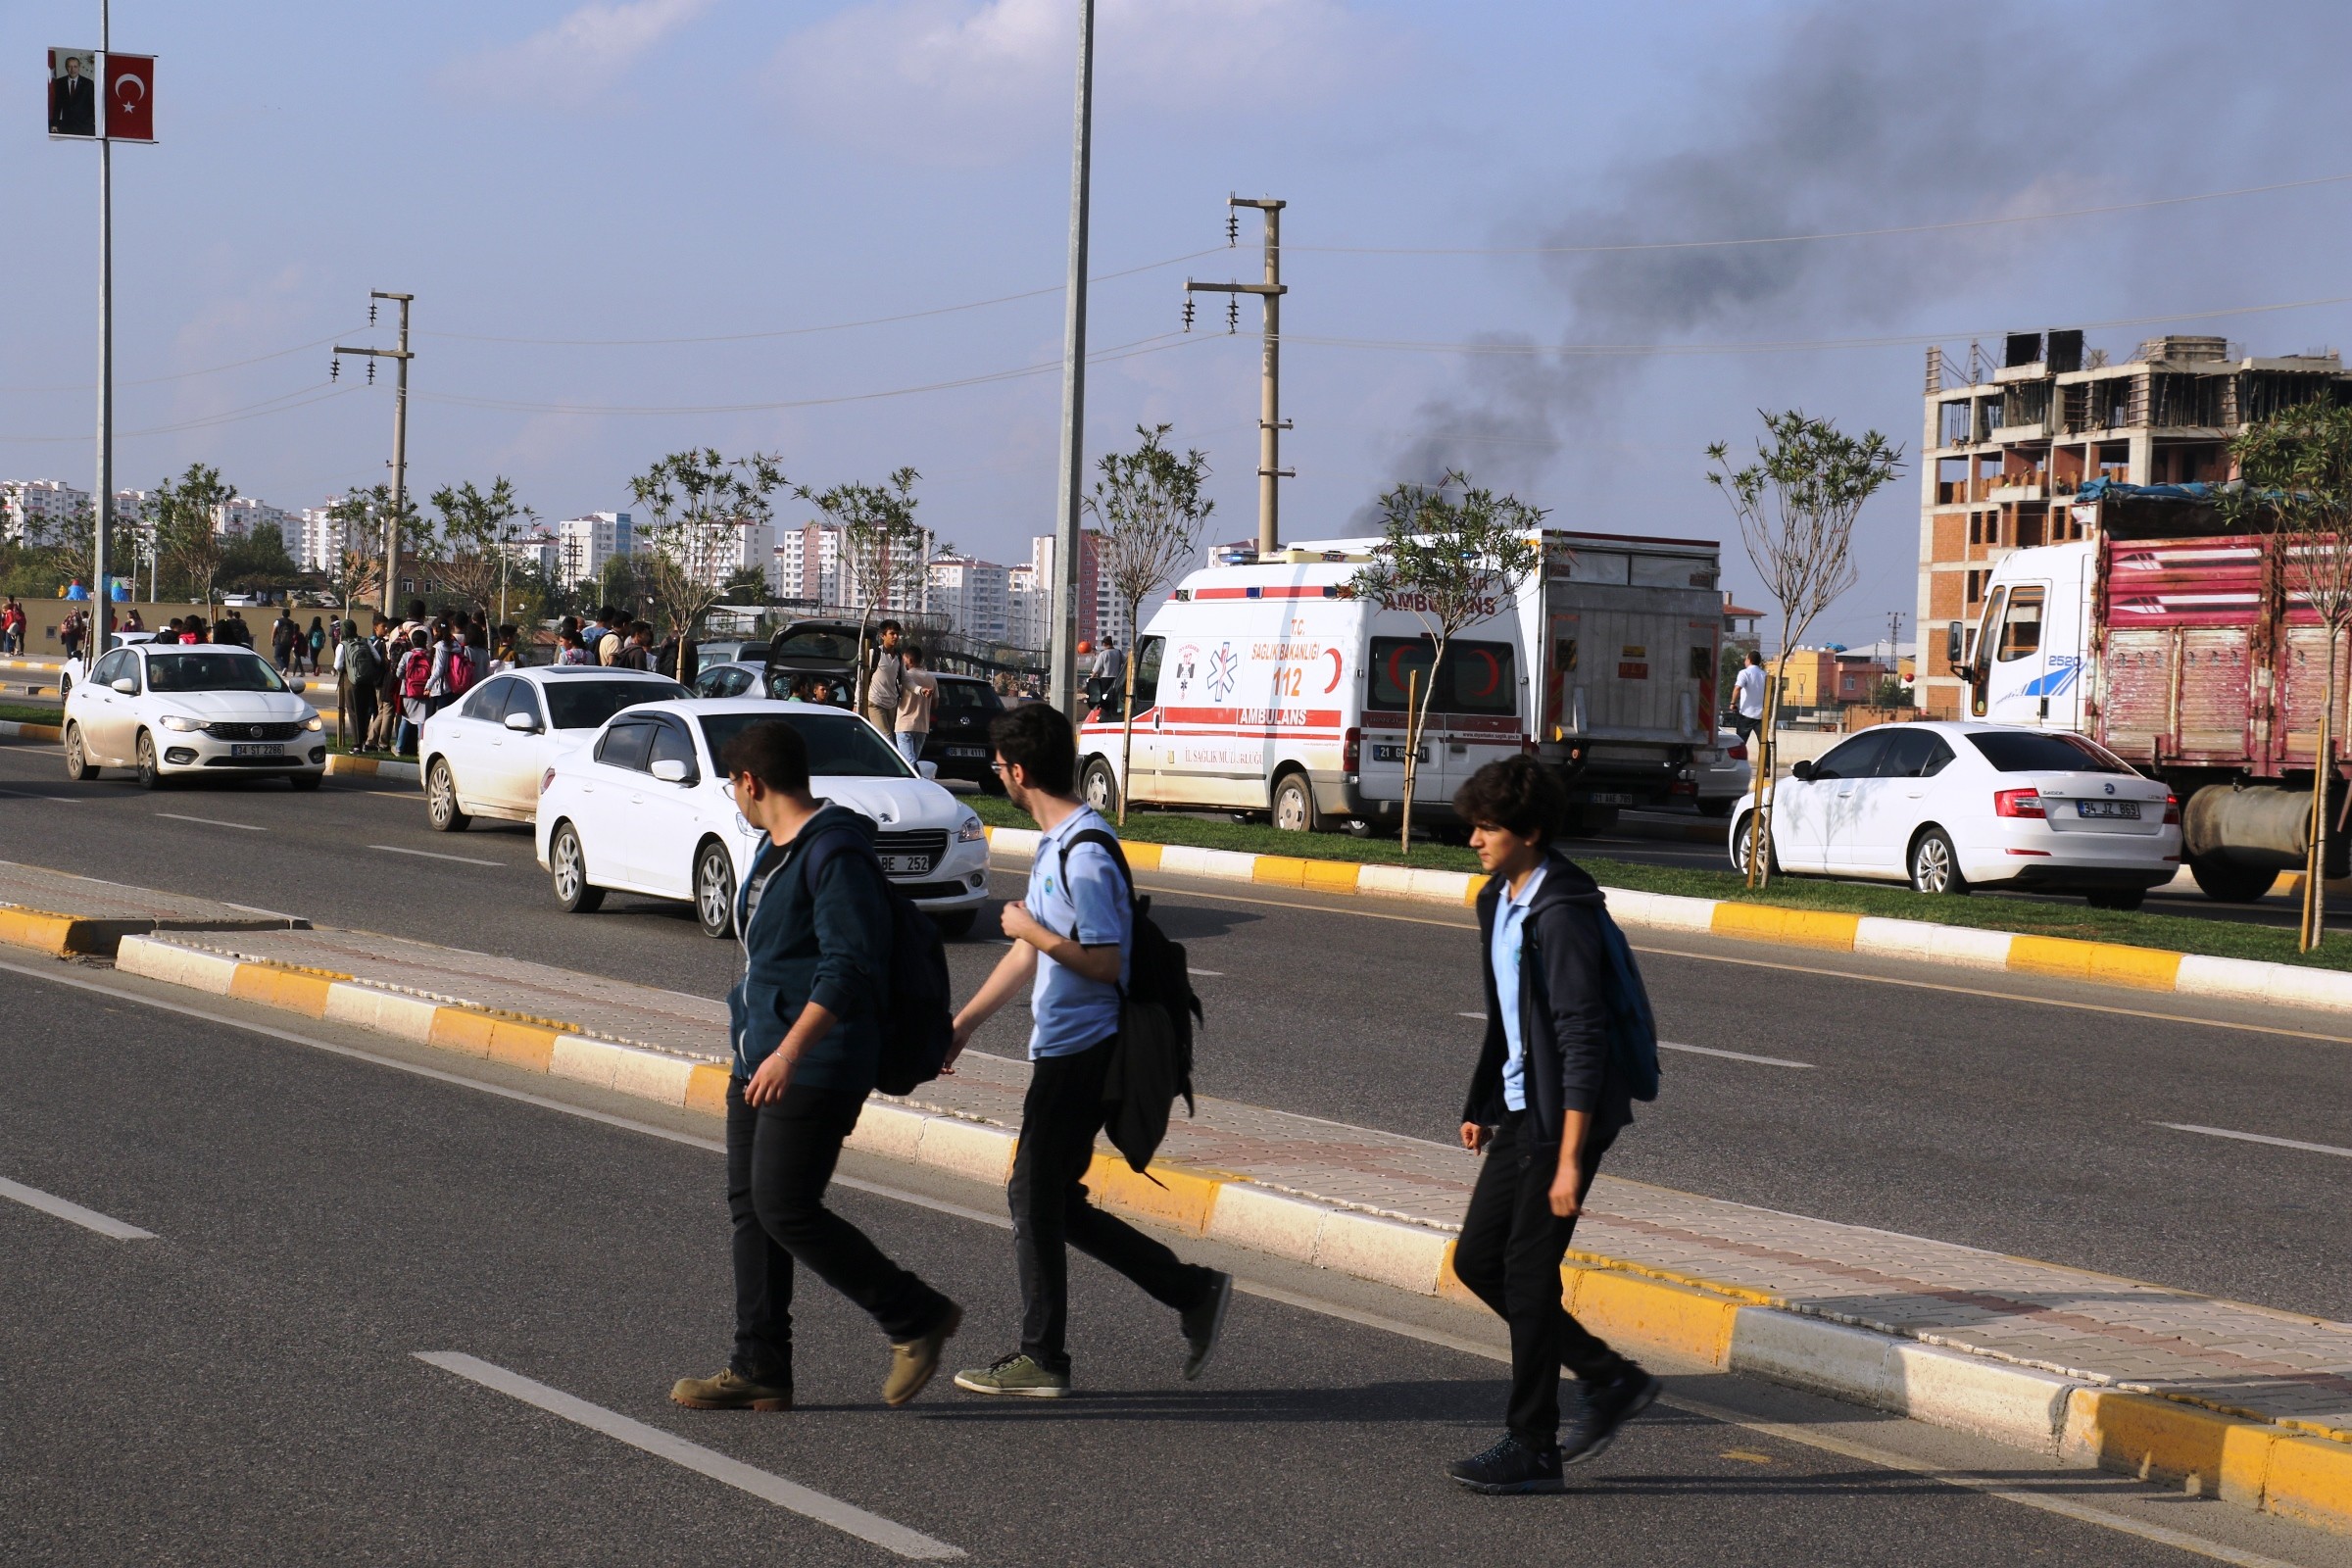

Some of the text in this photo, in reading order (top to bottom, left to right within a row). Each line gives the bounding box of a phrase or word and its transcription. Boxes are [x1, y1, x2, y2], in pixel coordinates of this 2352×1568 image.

[2048, 655, 2082, 666] 2520
[1274, 666, 1301, 697] 112
[1240, 709, 1307, 726] AMBULANS
[1380, 747, 1390, 758] 21
[2084, 803, 2136, 815] 34 JZ 869
[882, 857, 927, 871] BE 252
